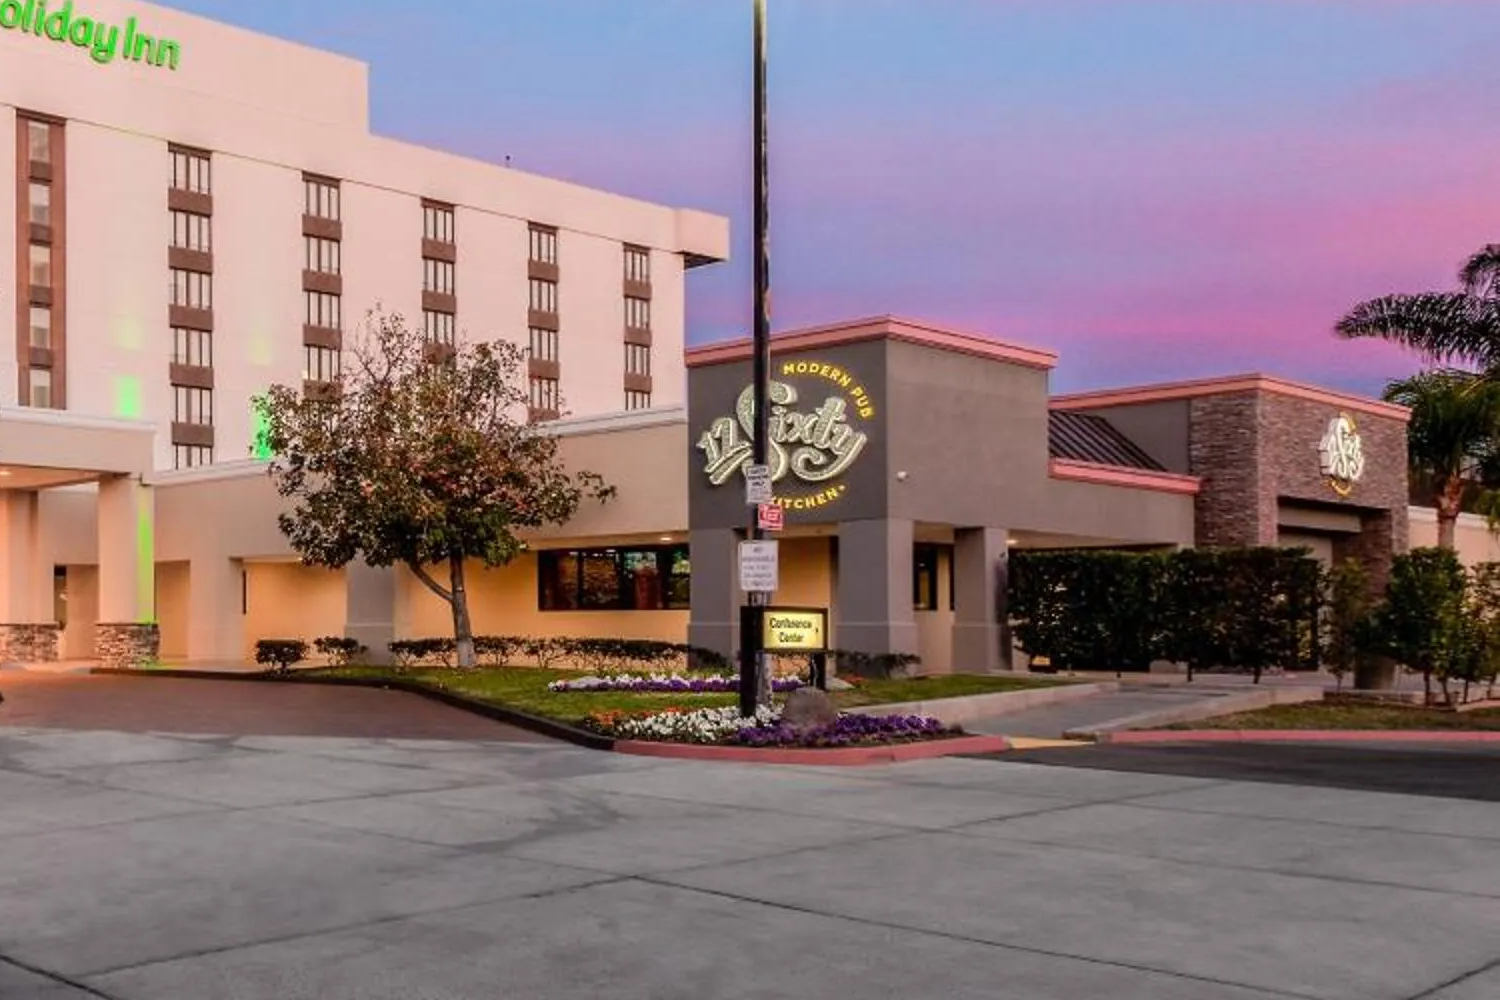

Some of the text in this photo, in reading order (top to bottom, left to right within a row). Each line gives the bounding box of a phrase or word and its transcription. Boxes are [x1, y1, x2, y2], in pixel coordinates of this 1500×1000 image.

[123, 17, 180, 70] Inn
[783, 362, 874, 418] MODERN PUB
